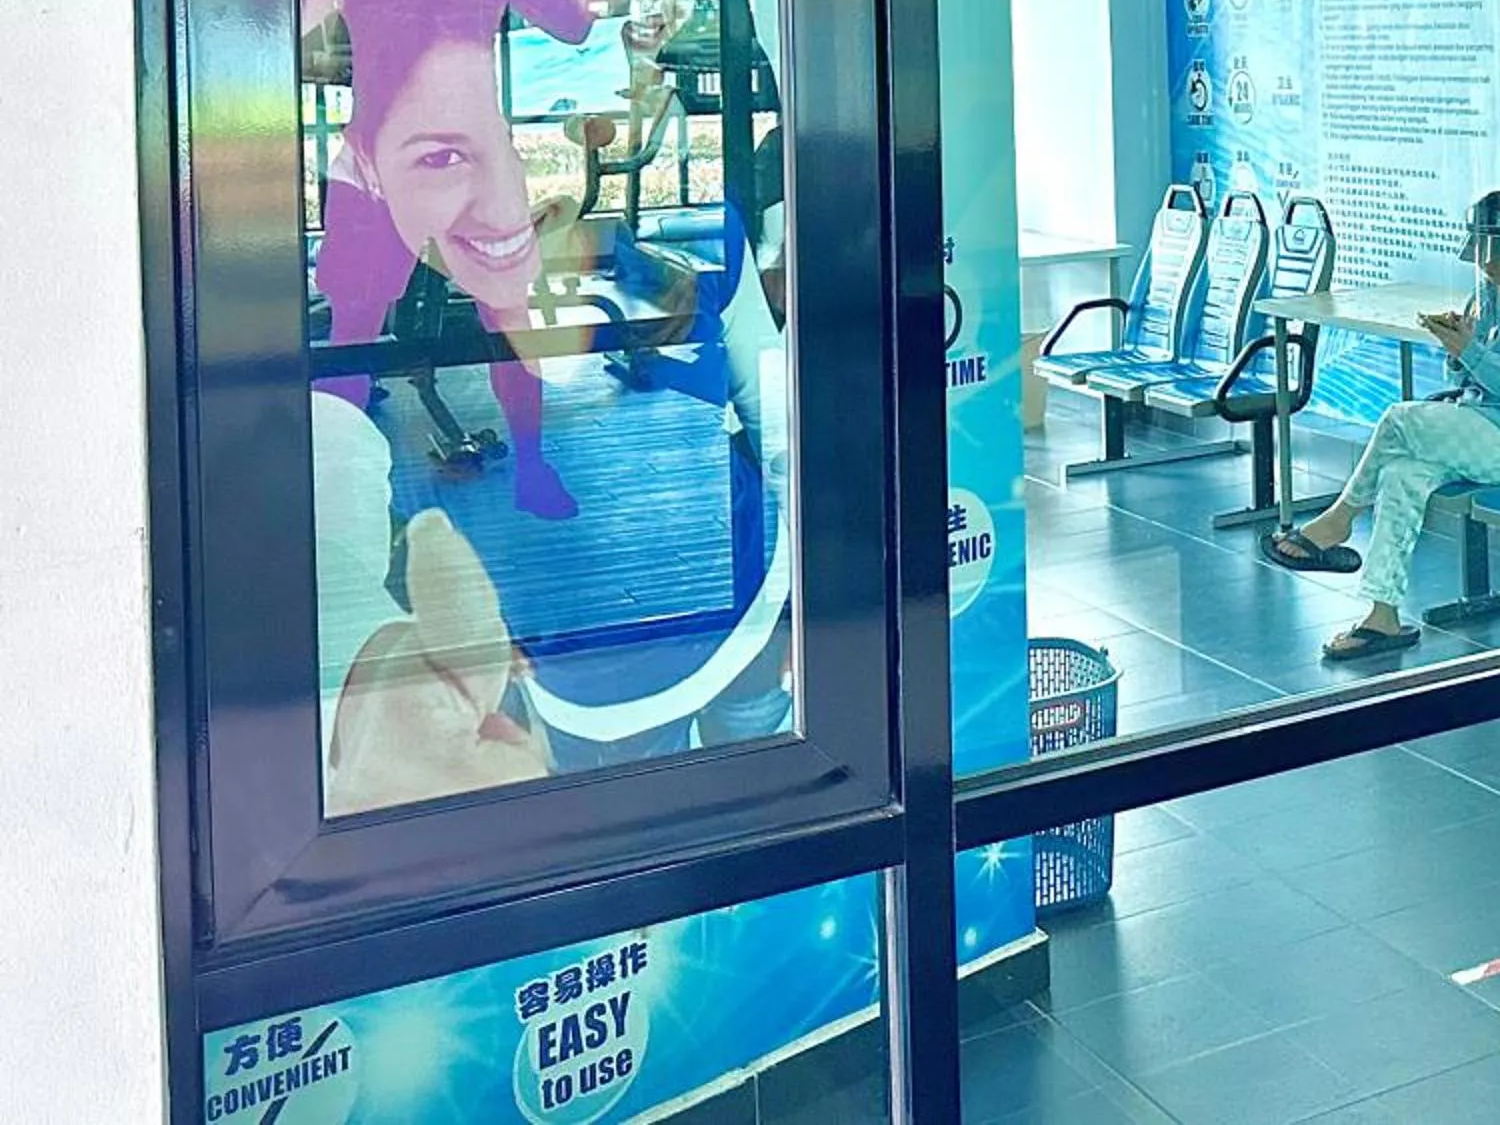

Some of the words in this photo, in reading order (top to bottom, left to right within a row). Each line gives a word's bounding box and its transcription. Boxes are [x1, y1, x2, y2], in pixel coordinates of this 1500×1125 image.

[517, 941, 648, 1019] 容易操作
[224, 1017, 303, 1074] 方便
[538, 991, 631, 1070] EASY
[207, 1045, 352, 1123] CONVENIENT
[541, 1073, 572, 1109] to
[579, 1048, 633, 1097] use
